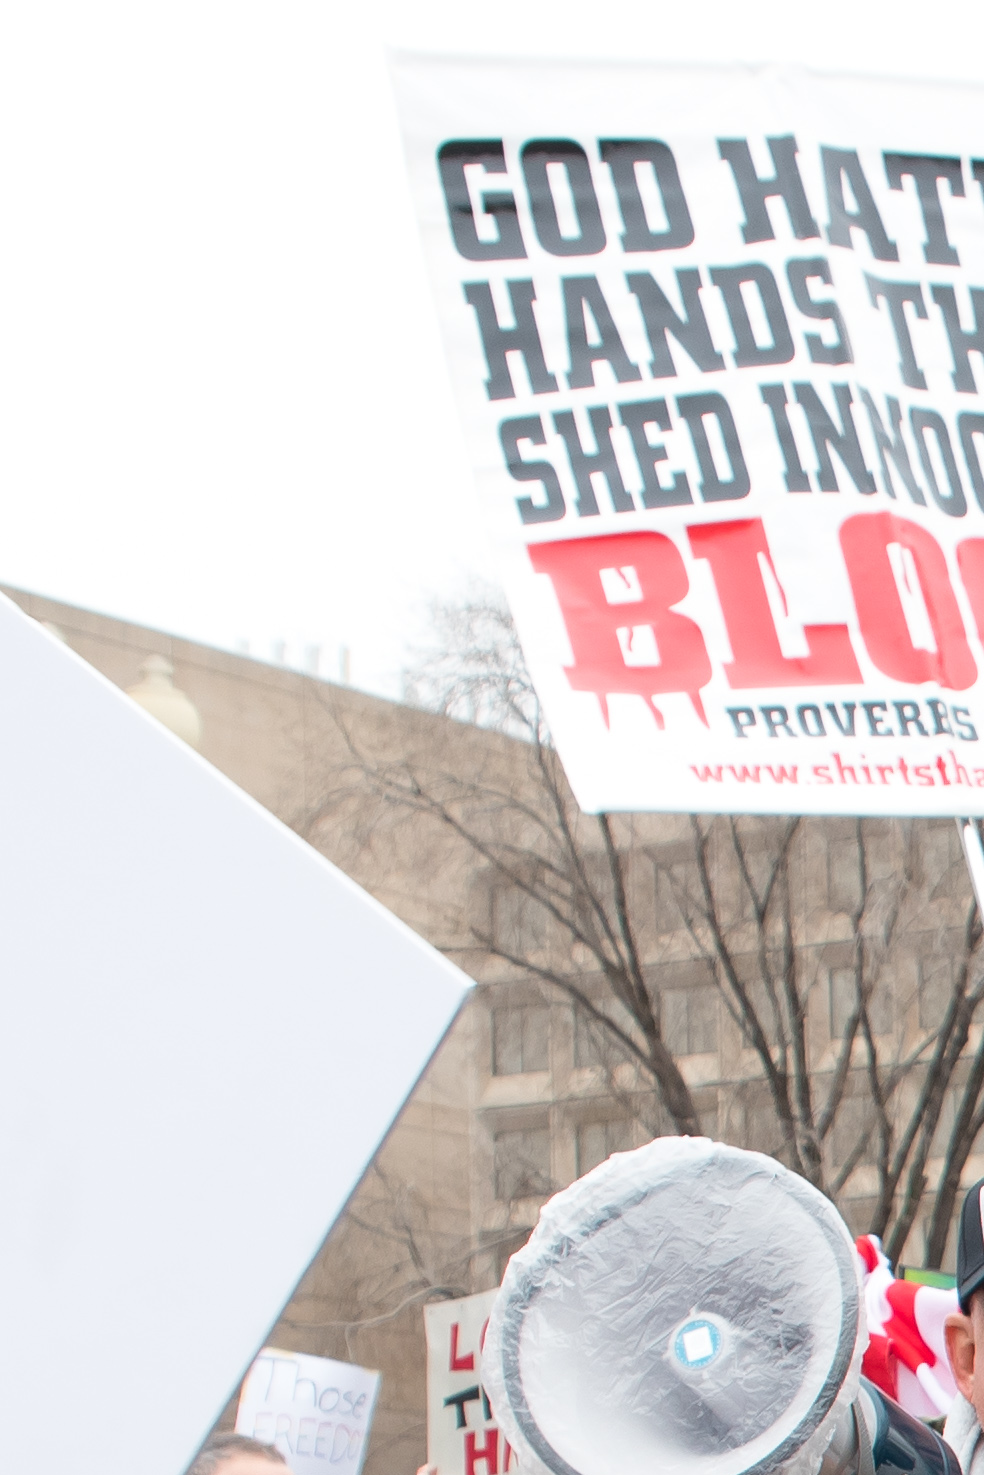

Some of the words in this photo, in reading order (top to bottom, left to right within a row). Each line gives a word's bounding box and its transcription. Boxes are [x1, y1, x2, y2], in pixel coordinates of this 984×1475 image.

[437, 136, 695, 263] GOD
[460, 255, 854, 402] HANDS
[499, 390, 751, 526] SHED
[725, 698, 980, 742] PROVERBS
[256, 1356, 368, 1420] Those
